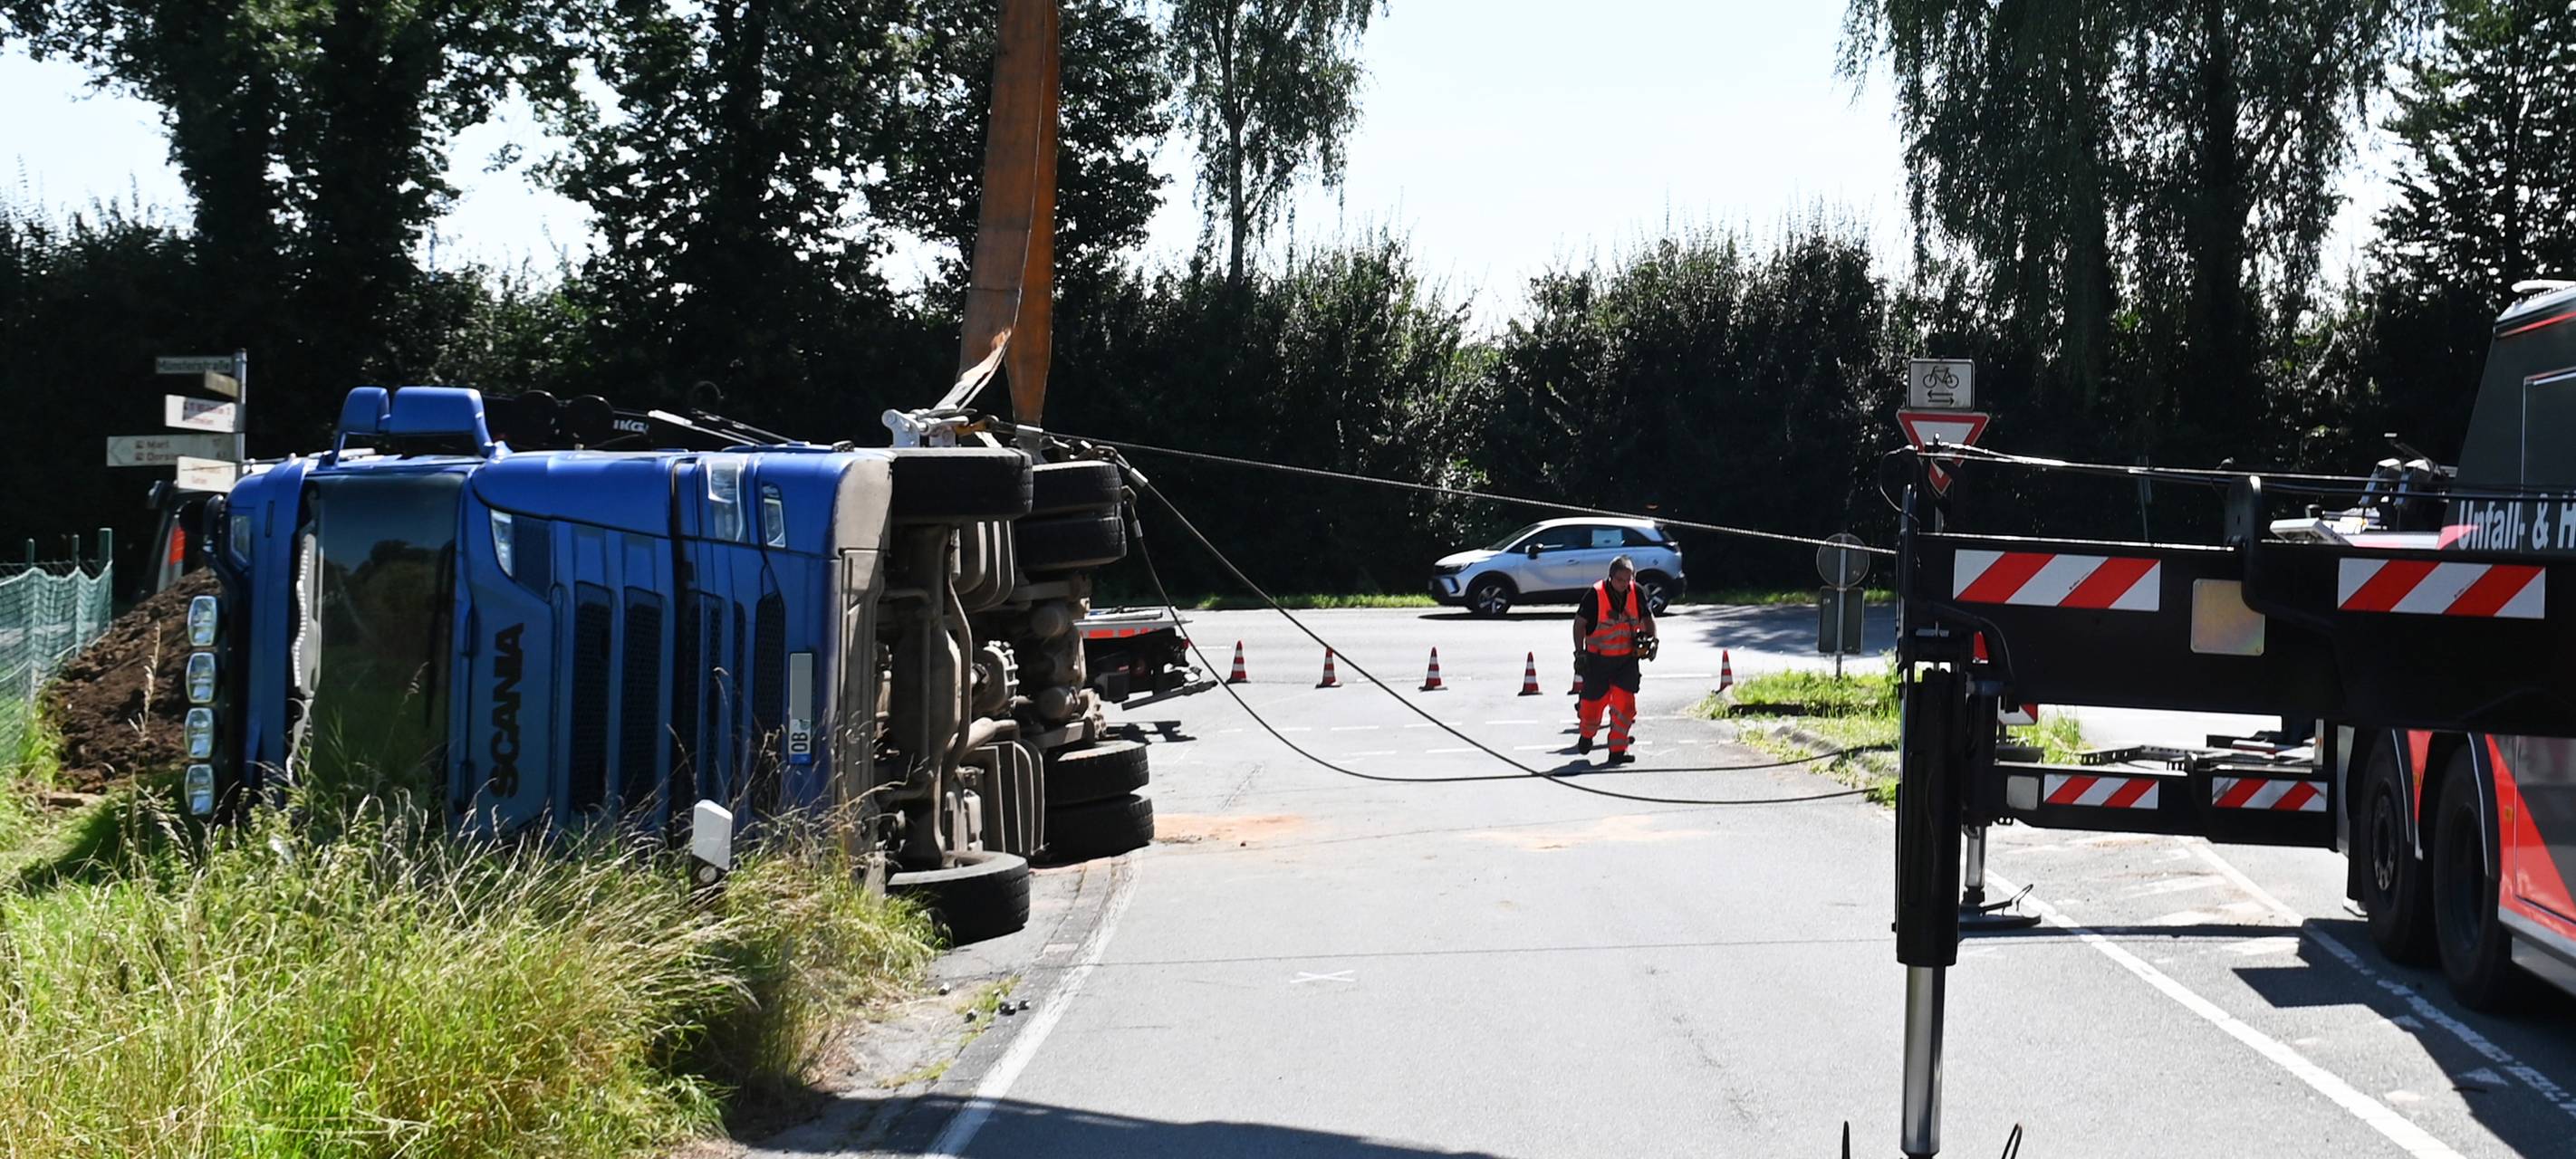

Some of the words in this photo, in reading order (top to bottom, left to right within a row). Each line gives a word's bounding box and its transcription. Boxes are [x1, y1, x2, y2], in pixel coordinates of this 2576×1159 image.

[2457, 500, 2525, 550] Unfall-
[2532, 493, 2549, 550] &
[490, 623, 524, 798] SCANIA
[791, 732, 809, 752] OB
